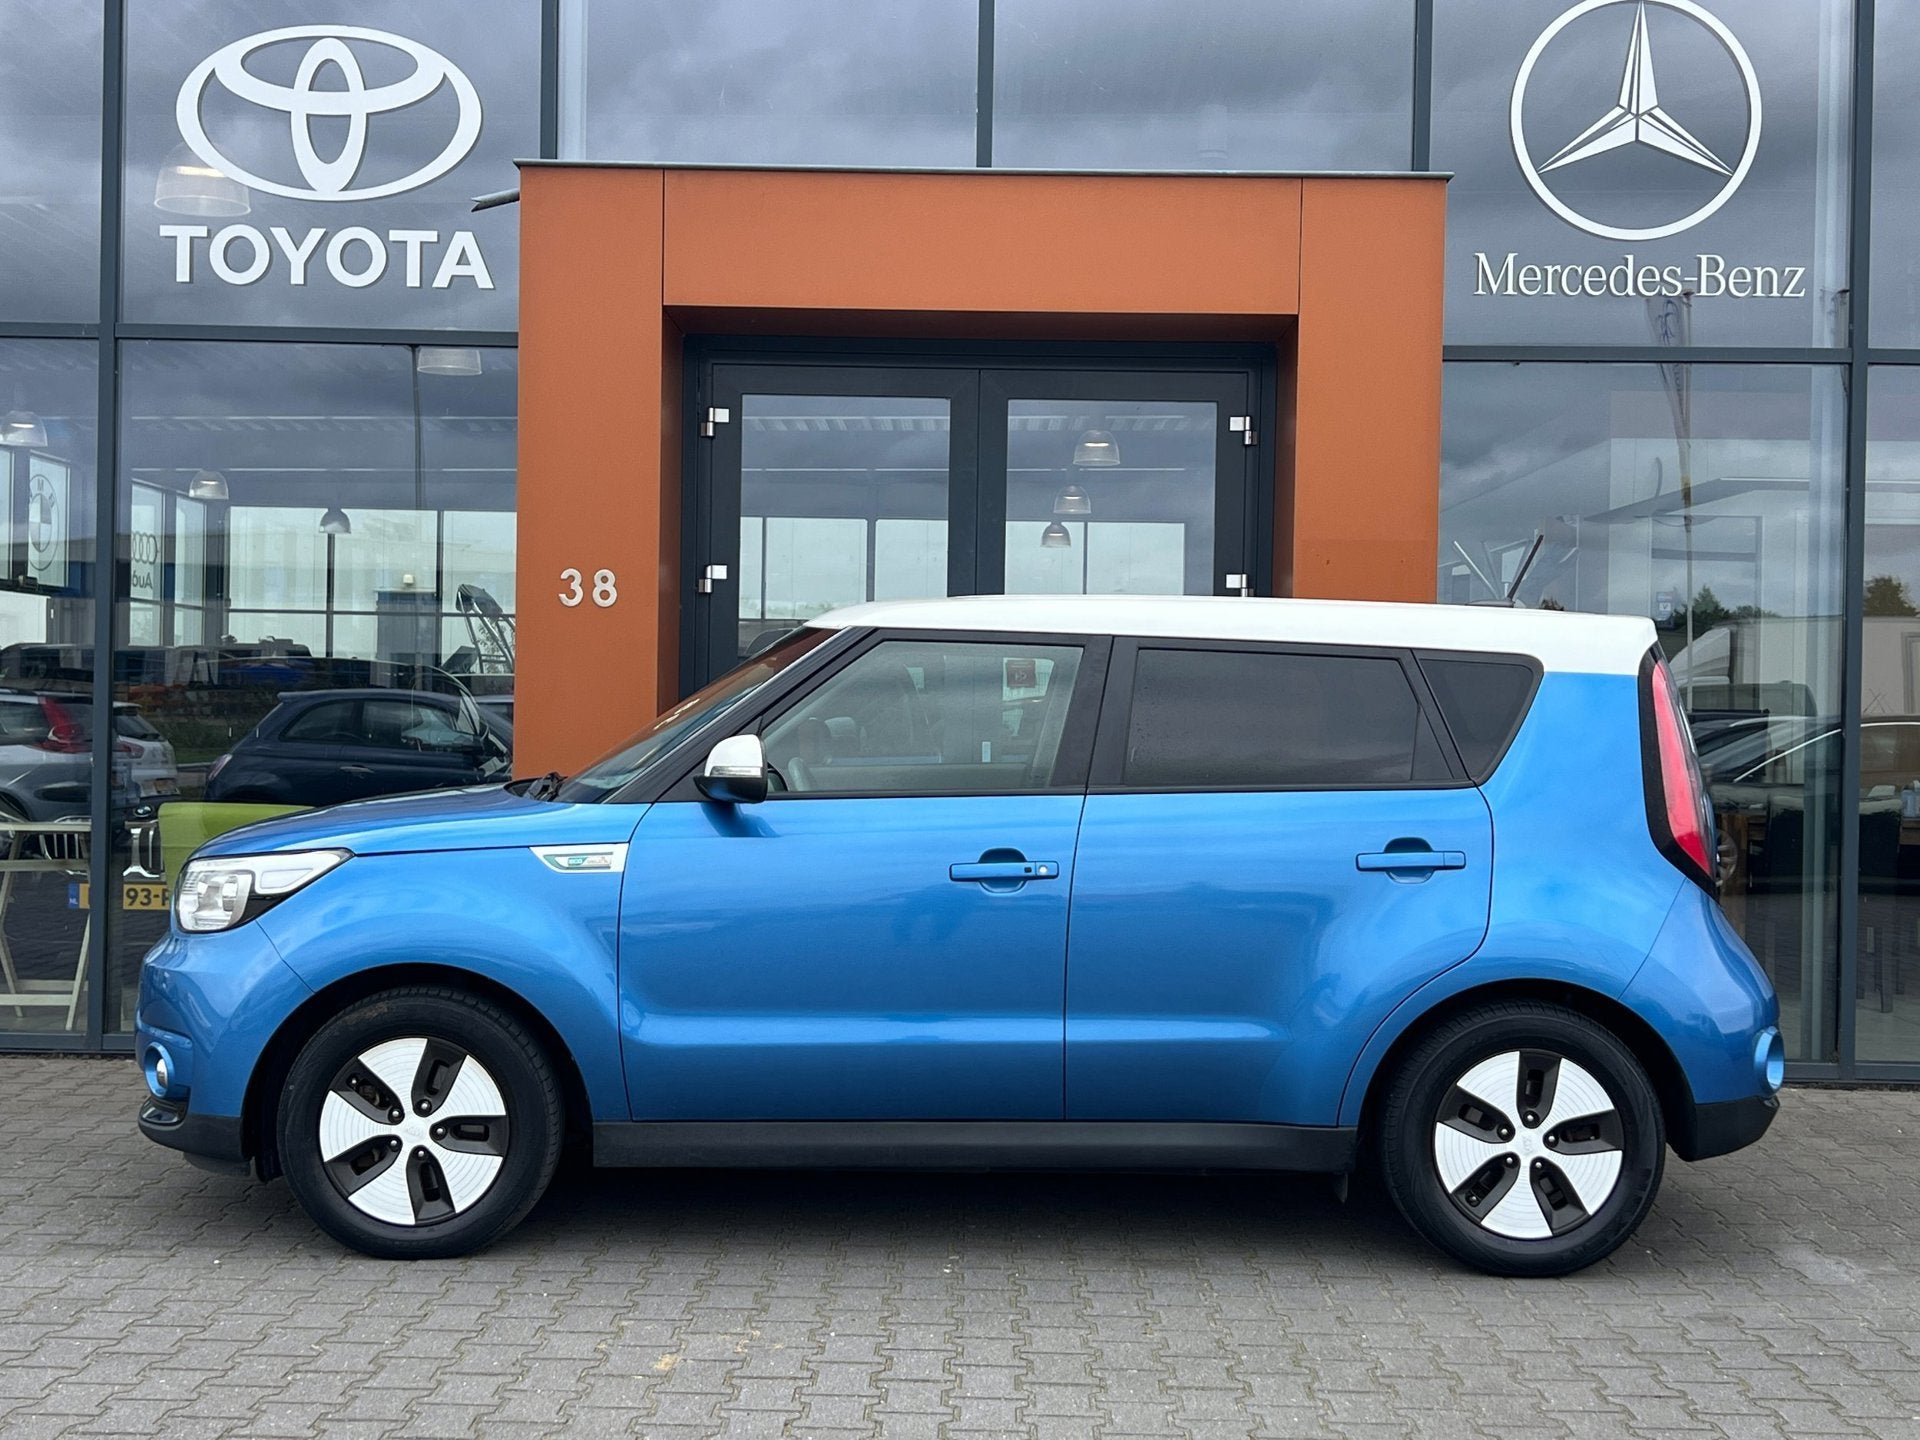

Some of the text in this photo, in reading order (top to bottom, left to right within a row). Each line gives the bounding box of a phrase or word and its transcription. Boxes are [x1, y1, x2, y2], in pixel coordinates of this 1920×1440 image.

[159, 224, 495, 289] TOYOTA
[1473, 251, 1806, 299] Mercedes-Benz
[558, 568, 618, 607] 38
